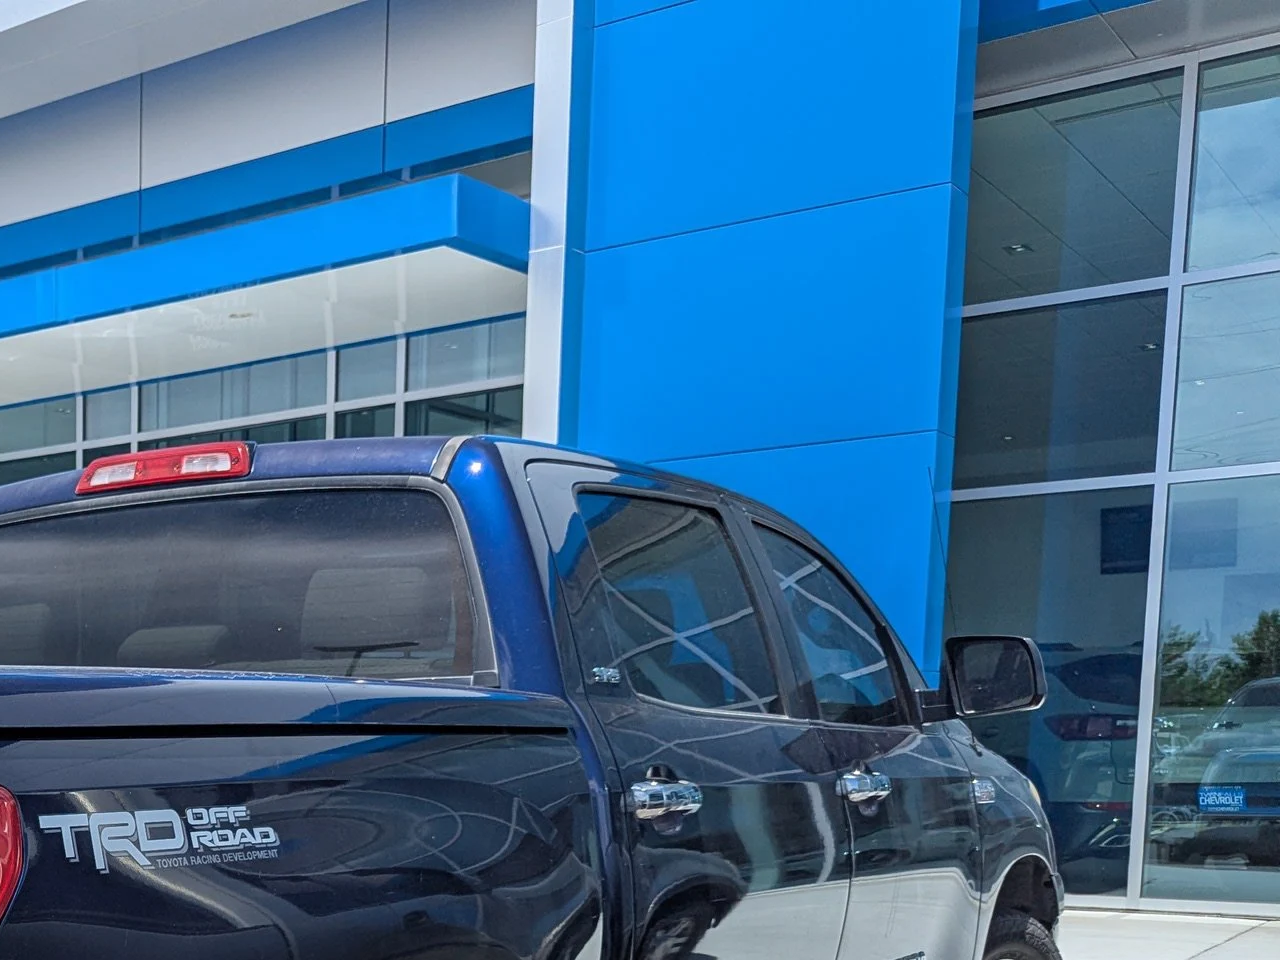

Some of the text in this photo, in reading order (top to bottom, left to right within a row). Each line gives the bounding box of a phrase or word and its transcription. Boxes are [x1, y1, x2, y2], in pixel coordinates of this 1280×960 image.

[1199, 796, 1243, 805] CHEVROLET
[38, 806, 250, 874] TRD OFF
[190, 826, 280, 851] ROAD
[156, 849, 279, 869] TOYOTA RACING DEVELOPMENT
